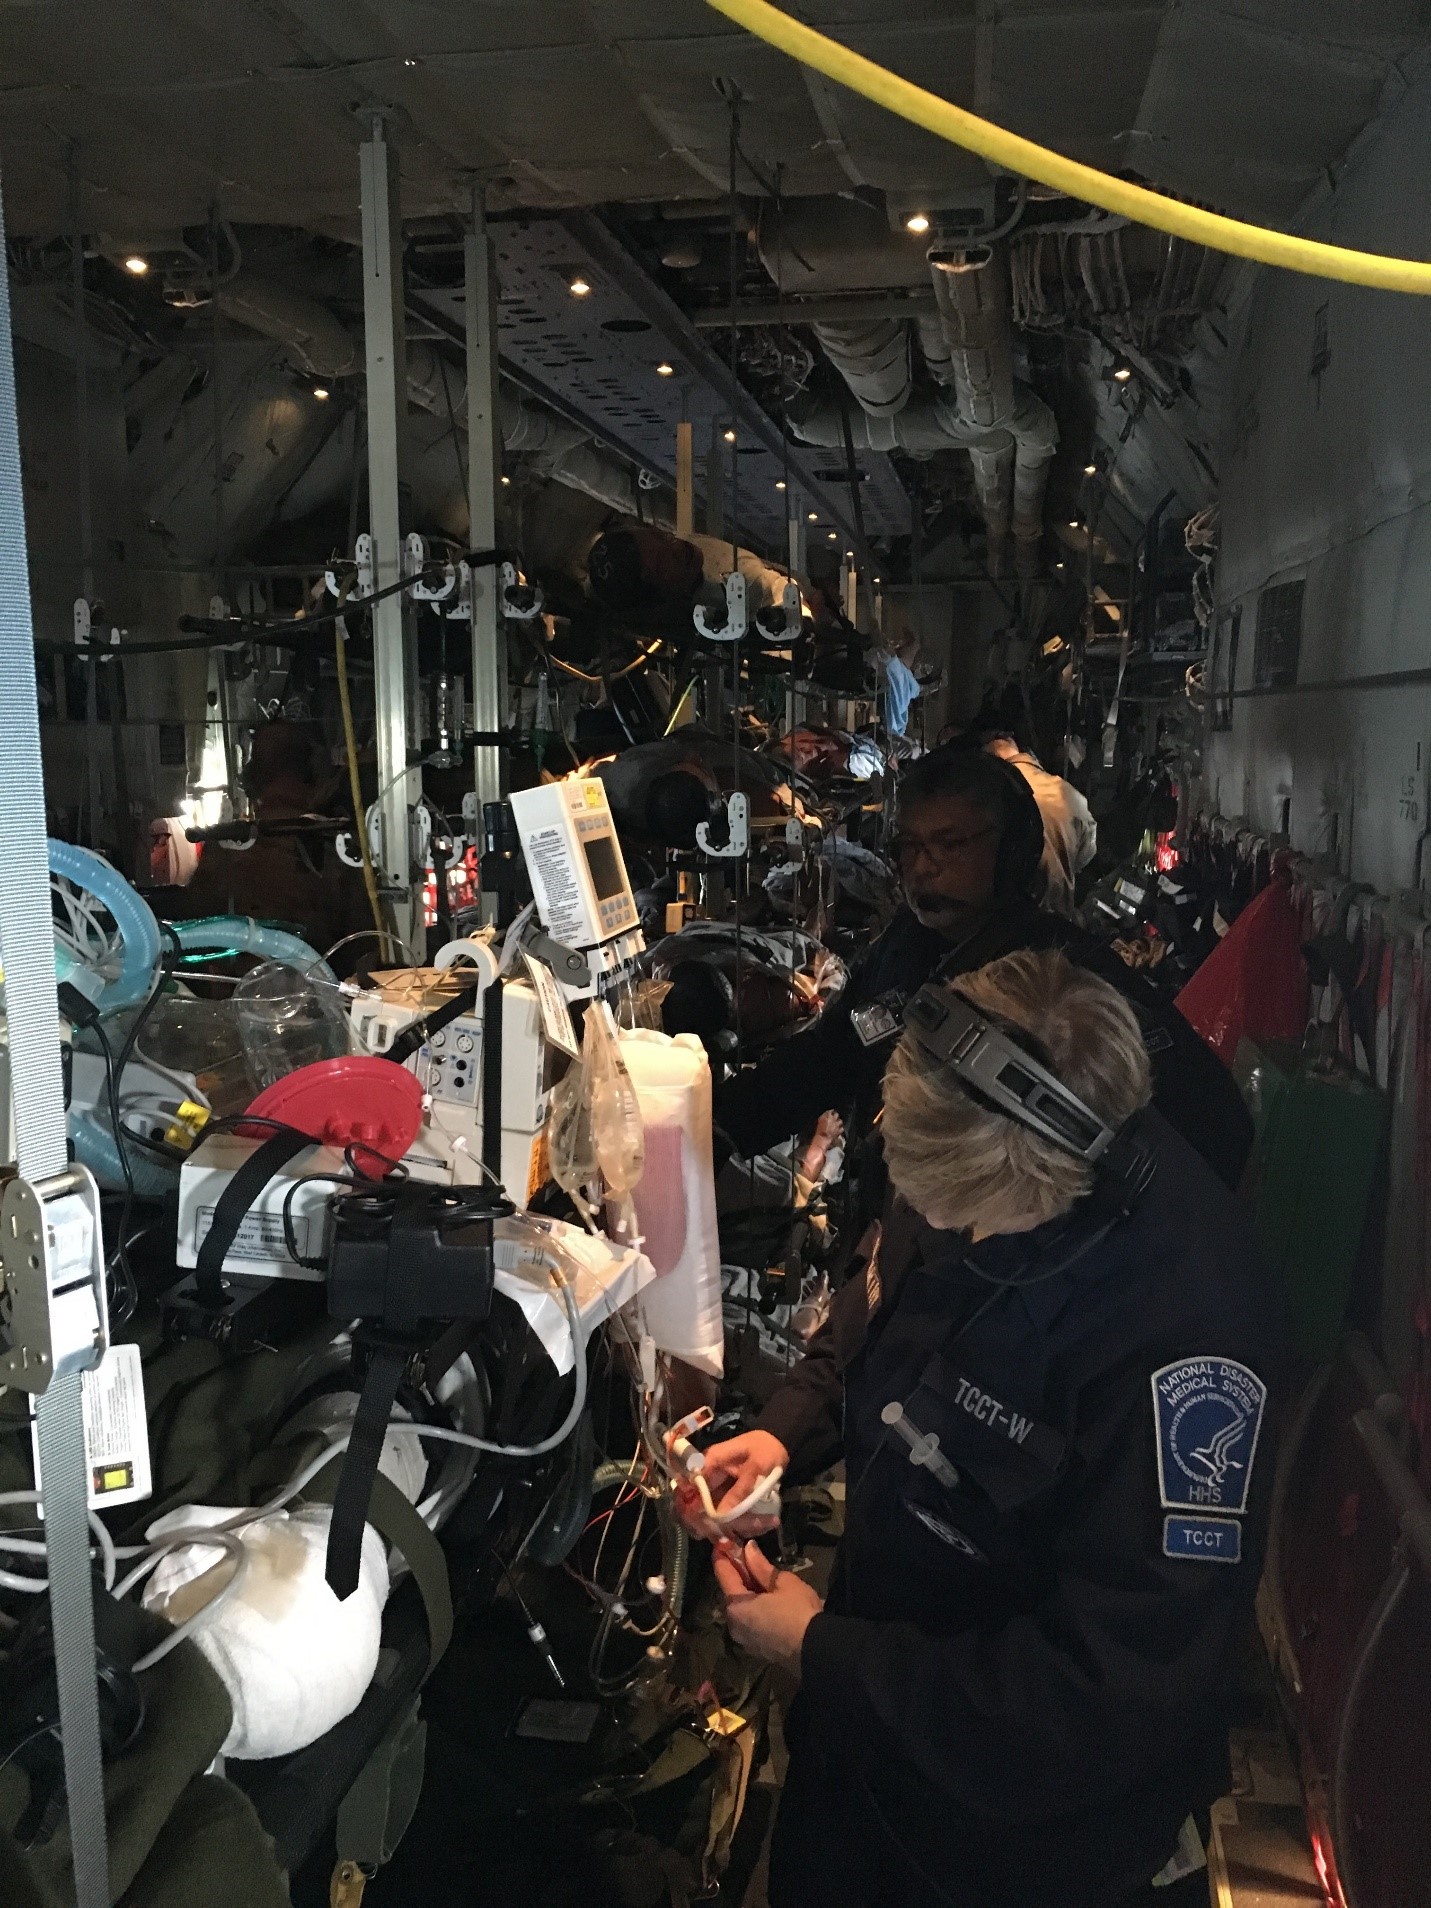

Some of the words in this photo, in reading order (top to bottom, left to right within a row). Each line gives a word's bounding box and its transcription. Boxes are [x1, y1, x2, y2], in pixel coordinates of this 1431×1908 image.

[1159, 1362, 1214, 1395] NATIONAL
[1220, 1364, 1261, 1404] DISASTER
[1167, 1377, 1216, 1408] MEDICAL
[954, 1377, 1034, 1444] TCCT-W
[1189, 1484, 1222, 1503] HHS
[1183, 1529, 1223, 1548] TCCT
